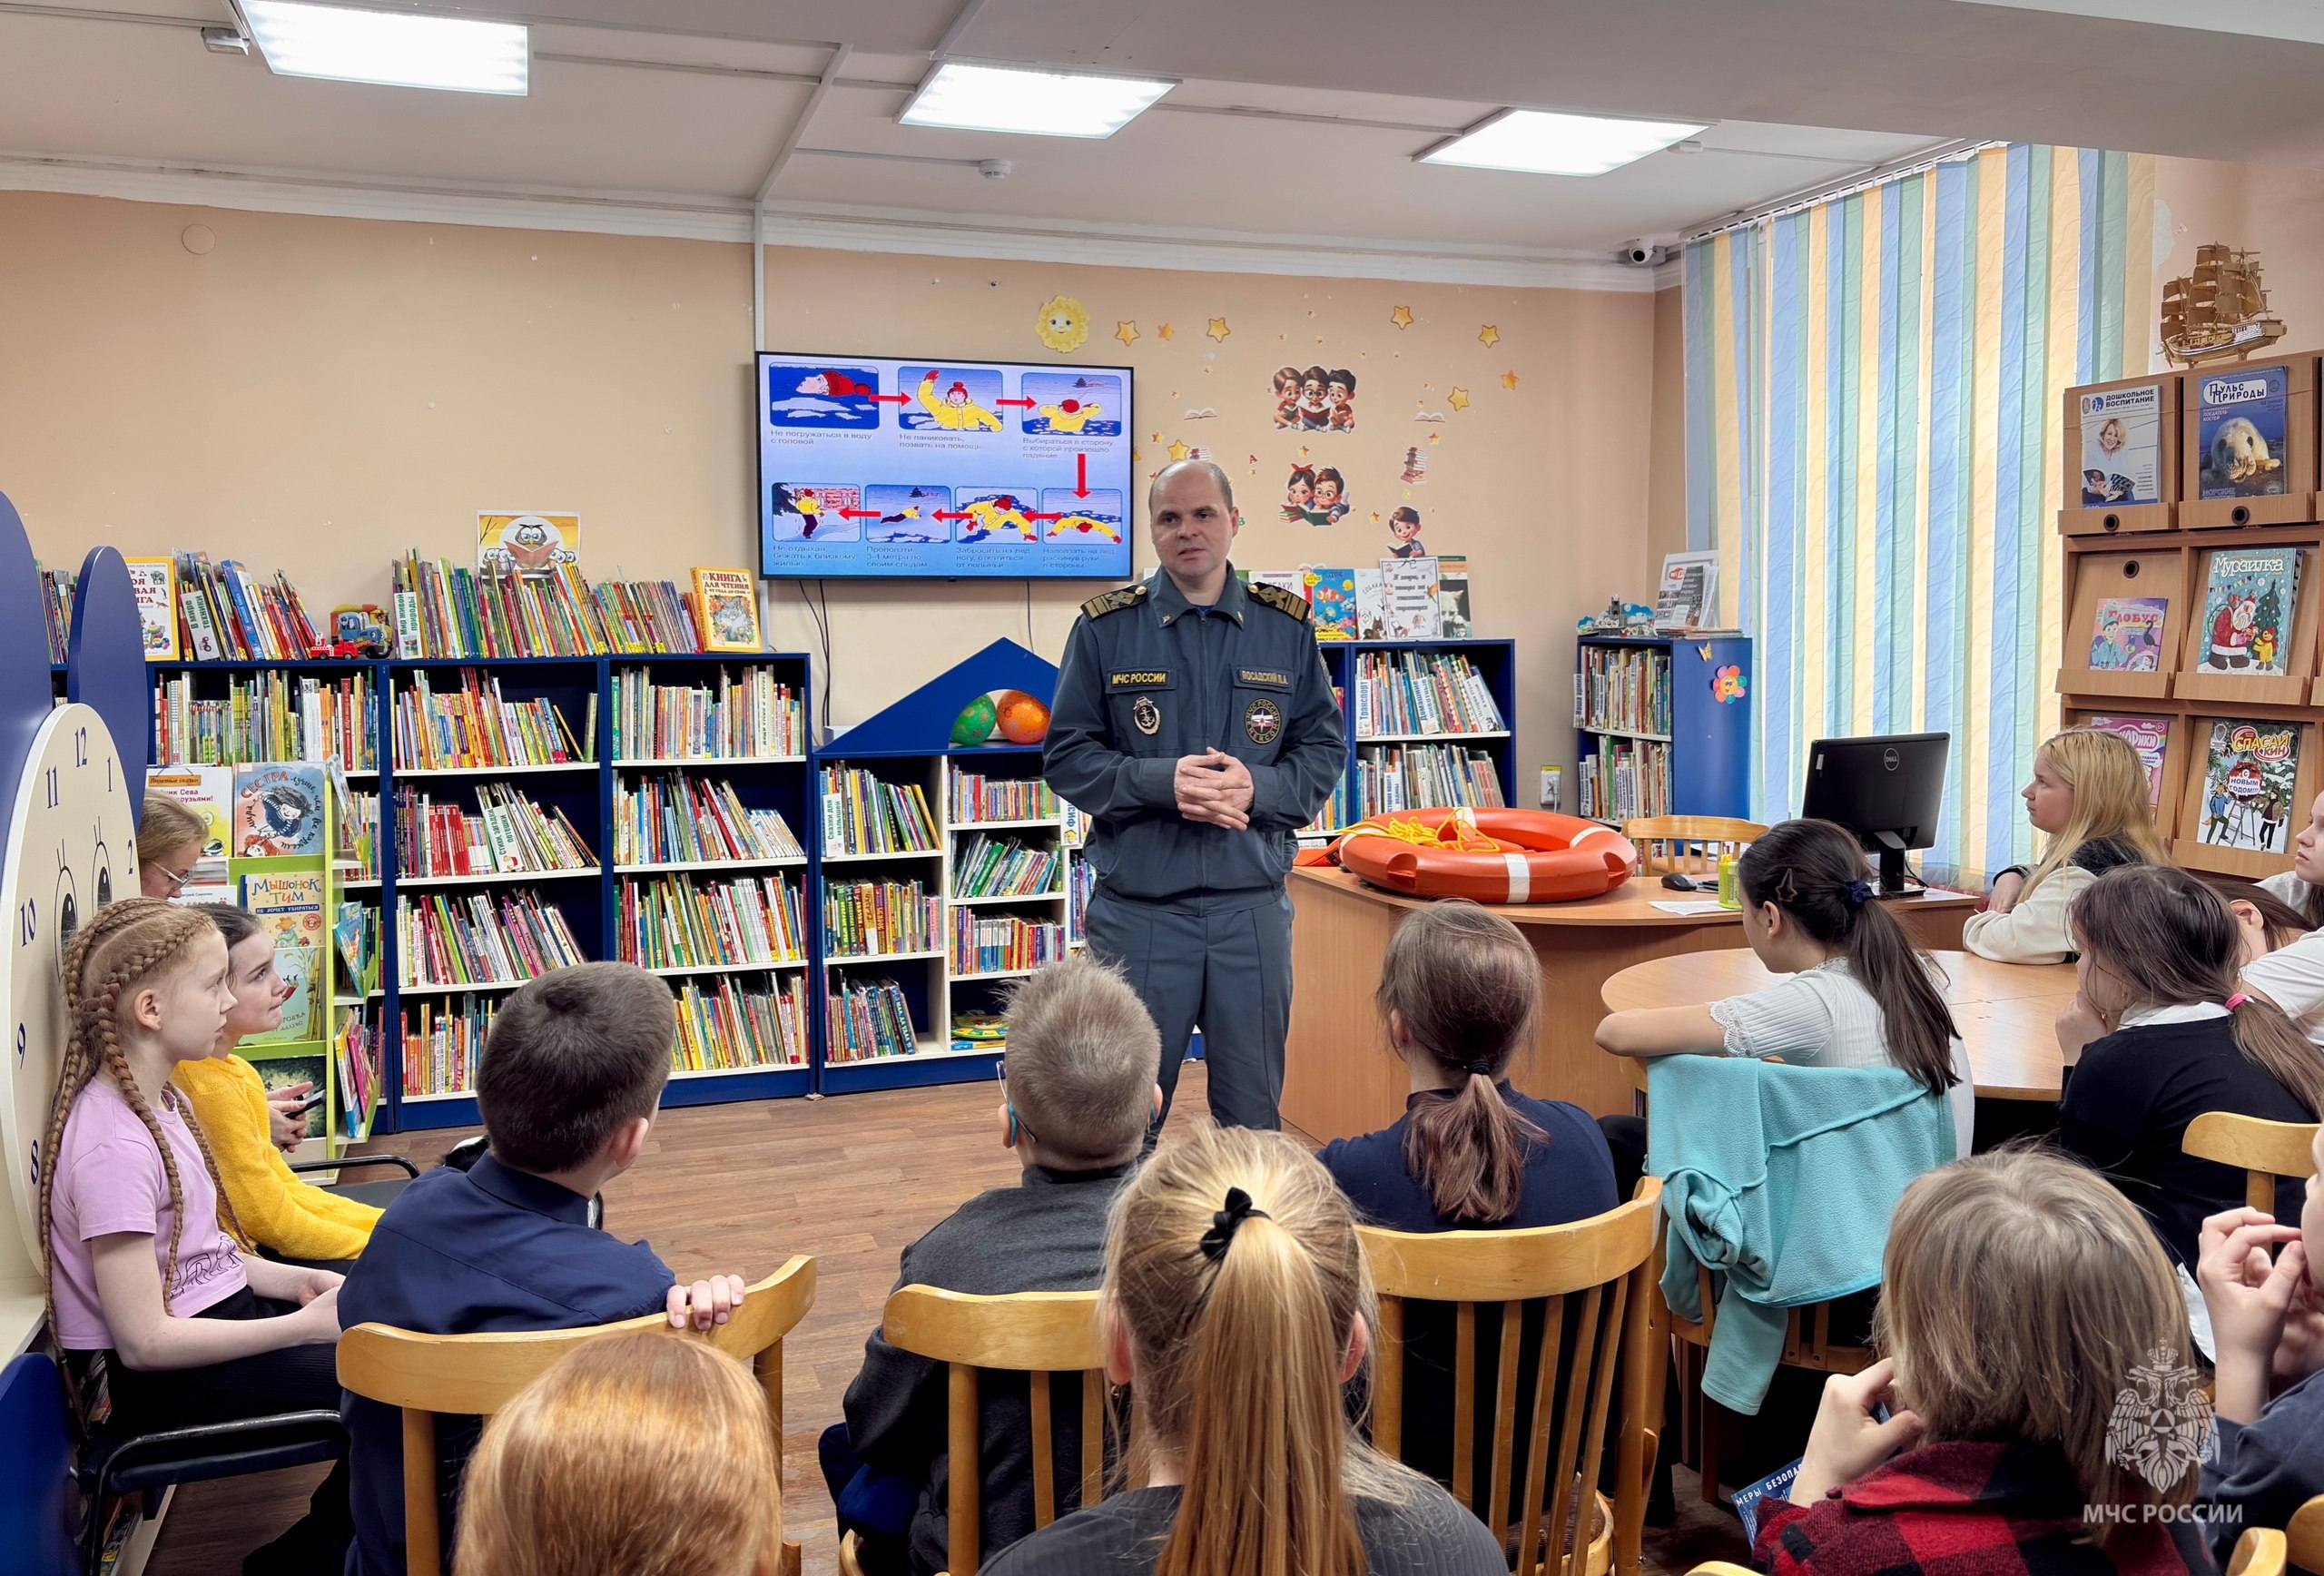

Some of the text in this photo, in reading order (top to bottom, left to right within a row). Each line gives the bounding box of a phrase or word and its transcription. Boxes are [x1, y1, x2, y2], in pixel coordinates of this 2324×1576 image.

[2105, 395, 2155, 408] ВОСПИТАНИЕ
[2106, 389, 2154, 401] ДОШКОЛЬНОЕ
[786, 430, 842, 439] погружаться
[708, 572, 743, 583] КНИГА
[721, 582, 750, 590] ЧТЕНИЯ
[185, 600, 197, 624] мире
[195, 595, 211, 629] техники
[397, 594, 408, 635] Мир живой
[408, 596, 419, 631] природы
[1112, 673, 1167, 685] МЧС РОССИИ
[1359, 681, 1369, 720] Транспорт
[1413, 681, 1428, 721] Домашние
[1421, 679, 1436, 719] животные
[74, 726, 87, 768] 12
[2232, 730, 2290, 752] СПАСАЙ
[45, 764, 60, 810] 11
[106, 756, 113, 793] 1
[241, 771, 289, 799] СЕСТРА
[2230, 778, 2259, 786] НОВЫМ
[487, 808, 501, 835] загадки
[500, 814, 514, 843] потешки
[827, 814, 835, 840] Сказки
[1066, 803, 1077, 827] ФИЗ
[127, 838, 134, 875] 2
[20, 896, 36, 948] 10
[16, 1021, 26, 1070] 9
[30, 1138, 39, 1186] 8
[1736, 1487, 1762, 1507] МЕРЫ
